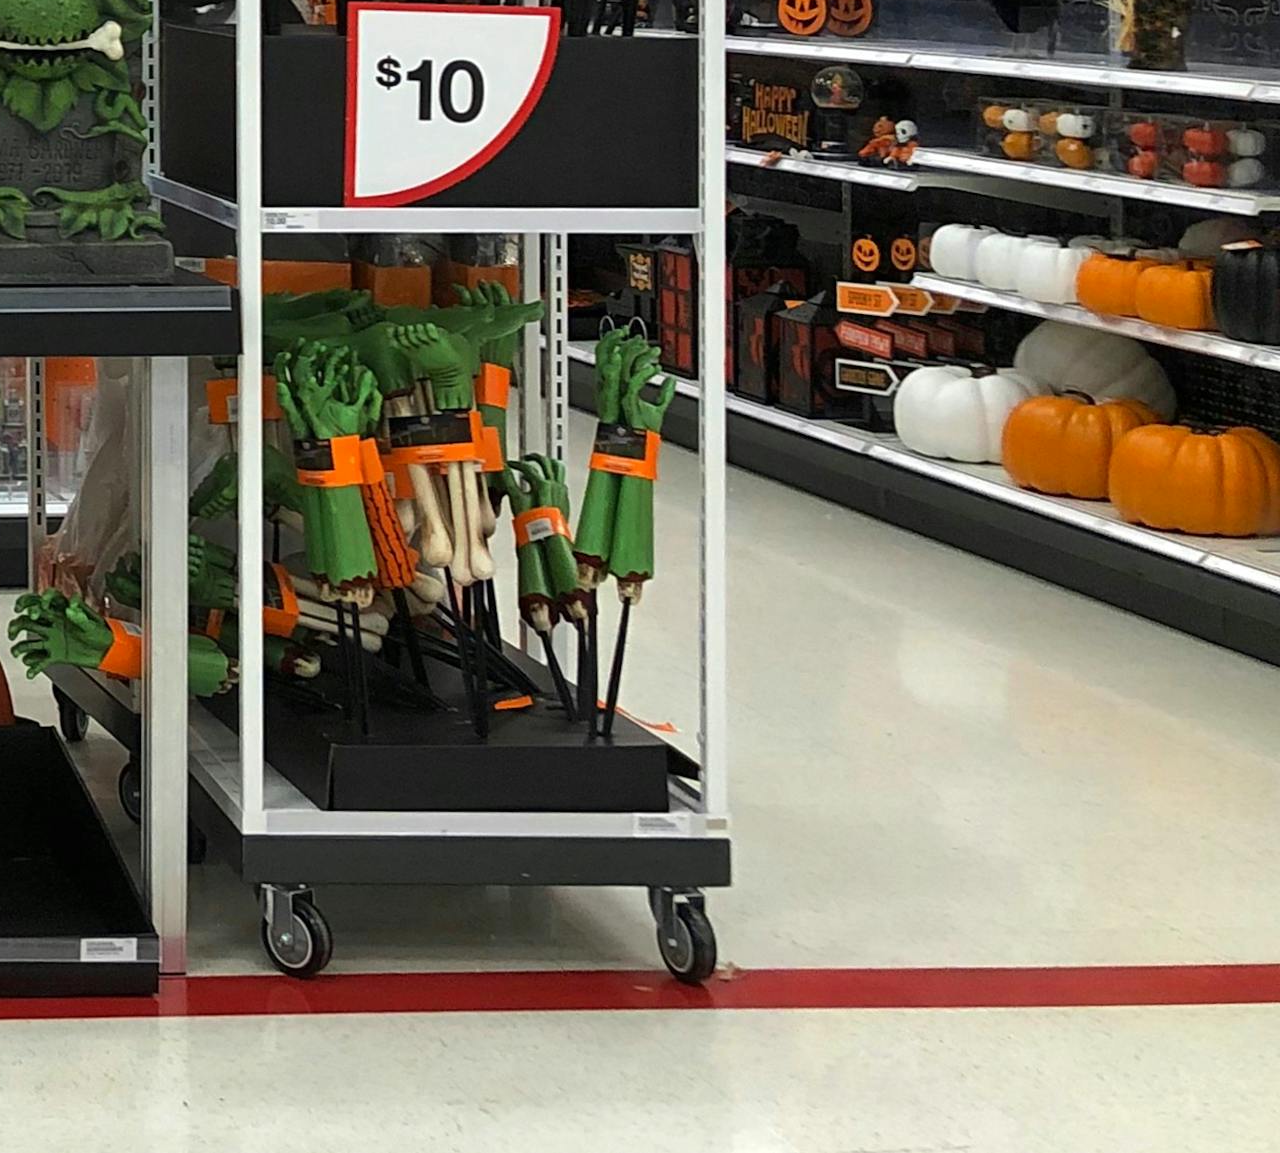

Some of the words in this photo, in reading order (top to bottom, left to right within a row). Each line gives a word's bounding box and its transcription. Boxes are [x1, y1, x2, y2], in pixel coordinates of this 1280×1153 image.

[376, 55, 485, 124] $10
[754, 82, 797, 112] HAPPY
[742, 105, 809, 147] HALLOWEEN
